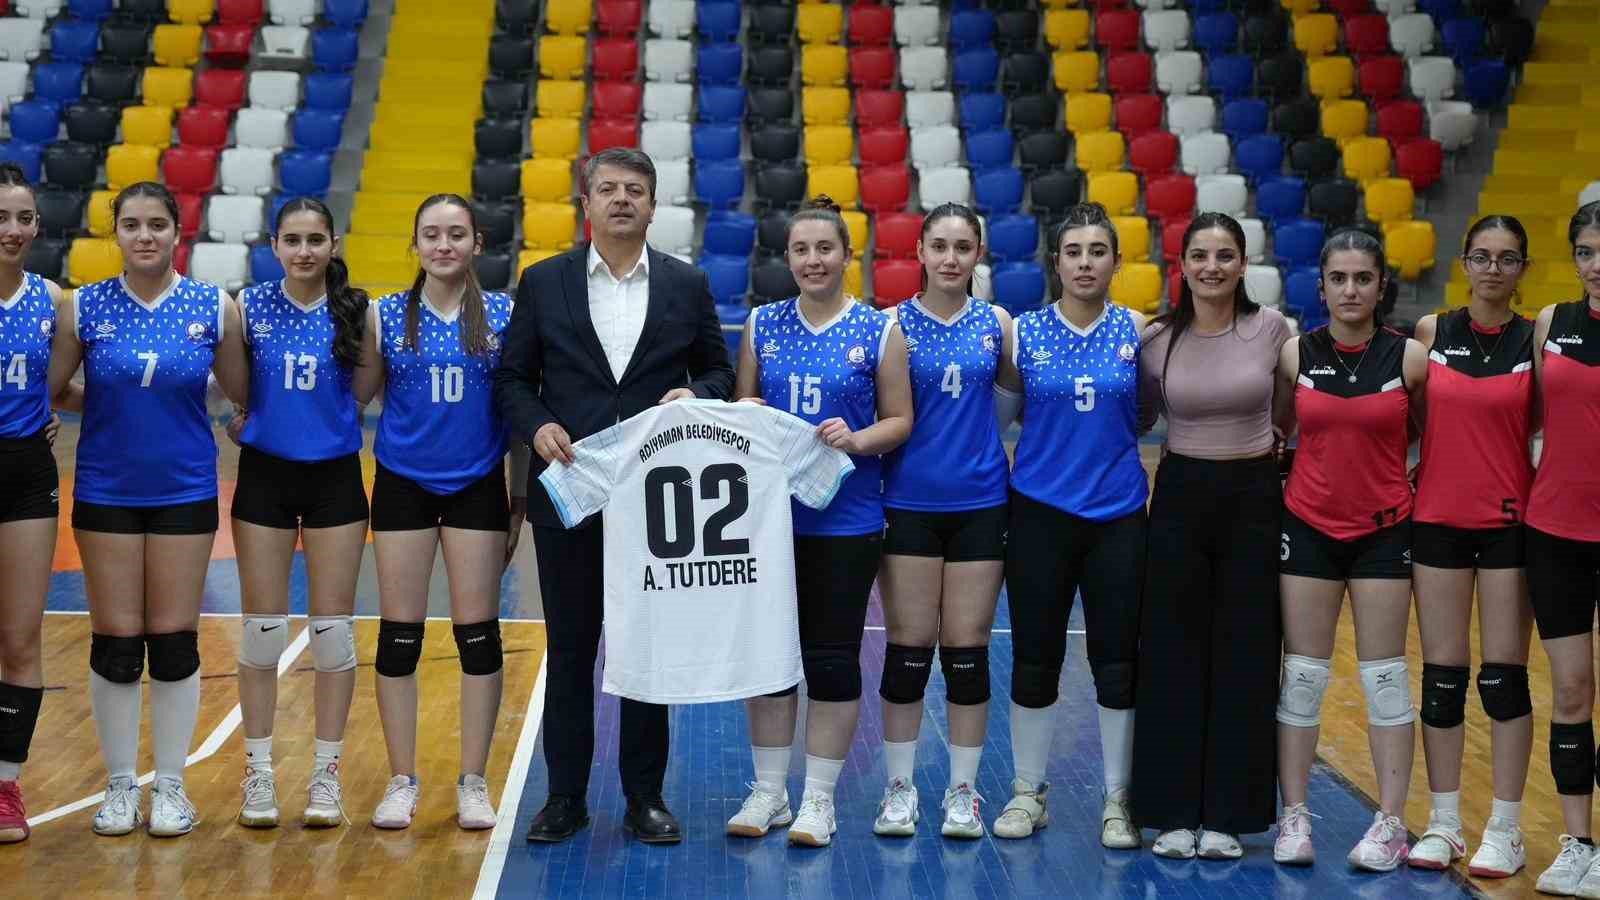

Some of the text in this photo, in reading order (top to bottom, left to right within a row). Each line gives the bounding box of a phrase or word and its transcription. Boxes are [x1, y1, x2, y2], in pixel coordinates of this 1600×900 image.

[0, 353, 28, 391] 4
[138, 352, 160, 387] 7
[284, 353, 318, 391] 13
[429, 366, 464, 403] 10
[941, 364, 963, 399] 4
[788, 374, 822, 415] 15
[1075, 376, 1095, 412] 5
[639, 422, 751, 463] ADIYAMAN BELEDİYESPOR
[644, 463, 750, 559] 02
[1501, 498, 1520, 525] 5
[643, 558, 757, 591] A. TUTDERE
